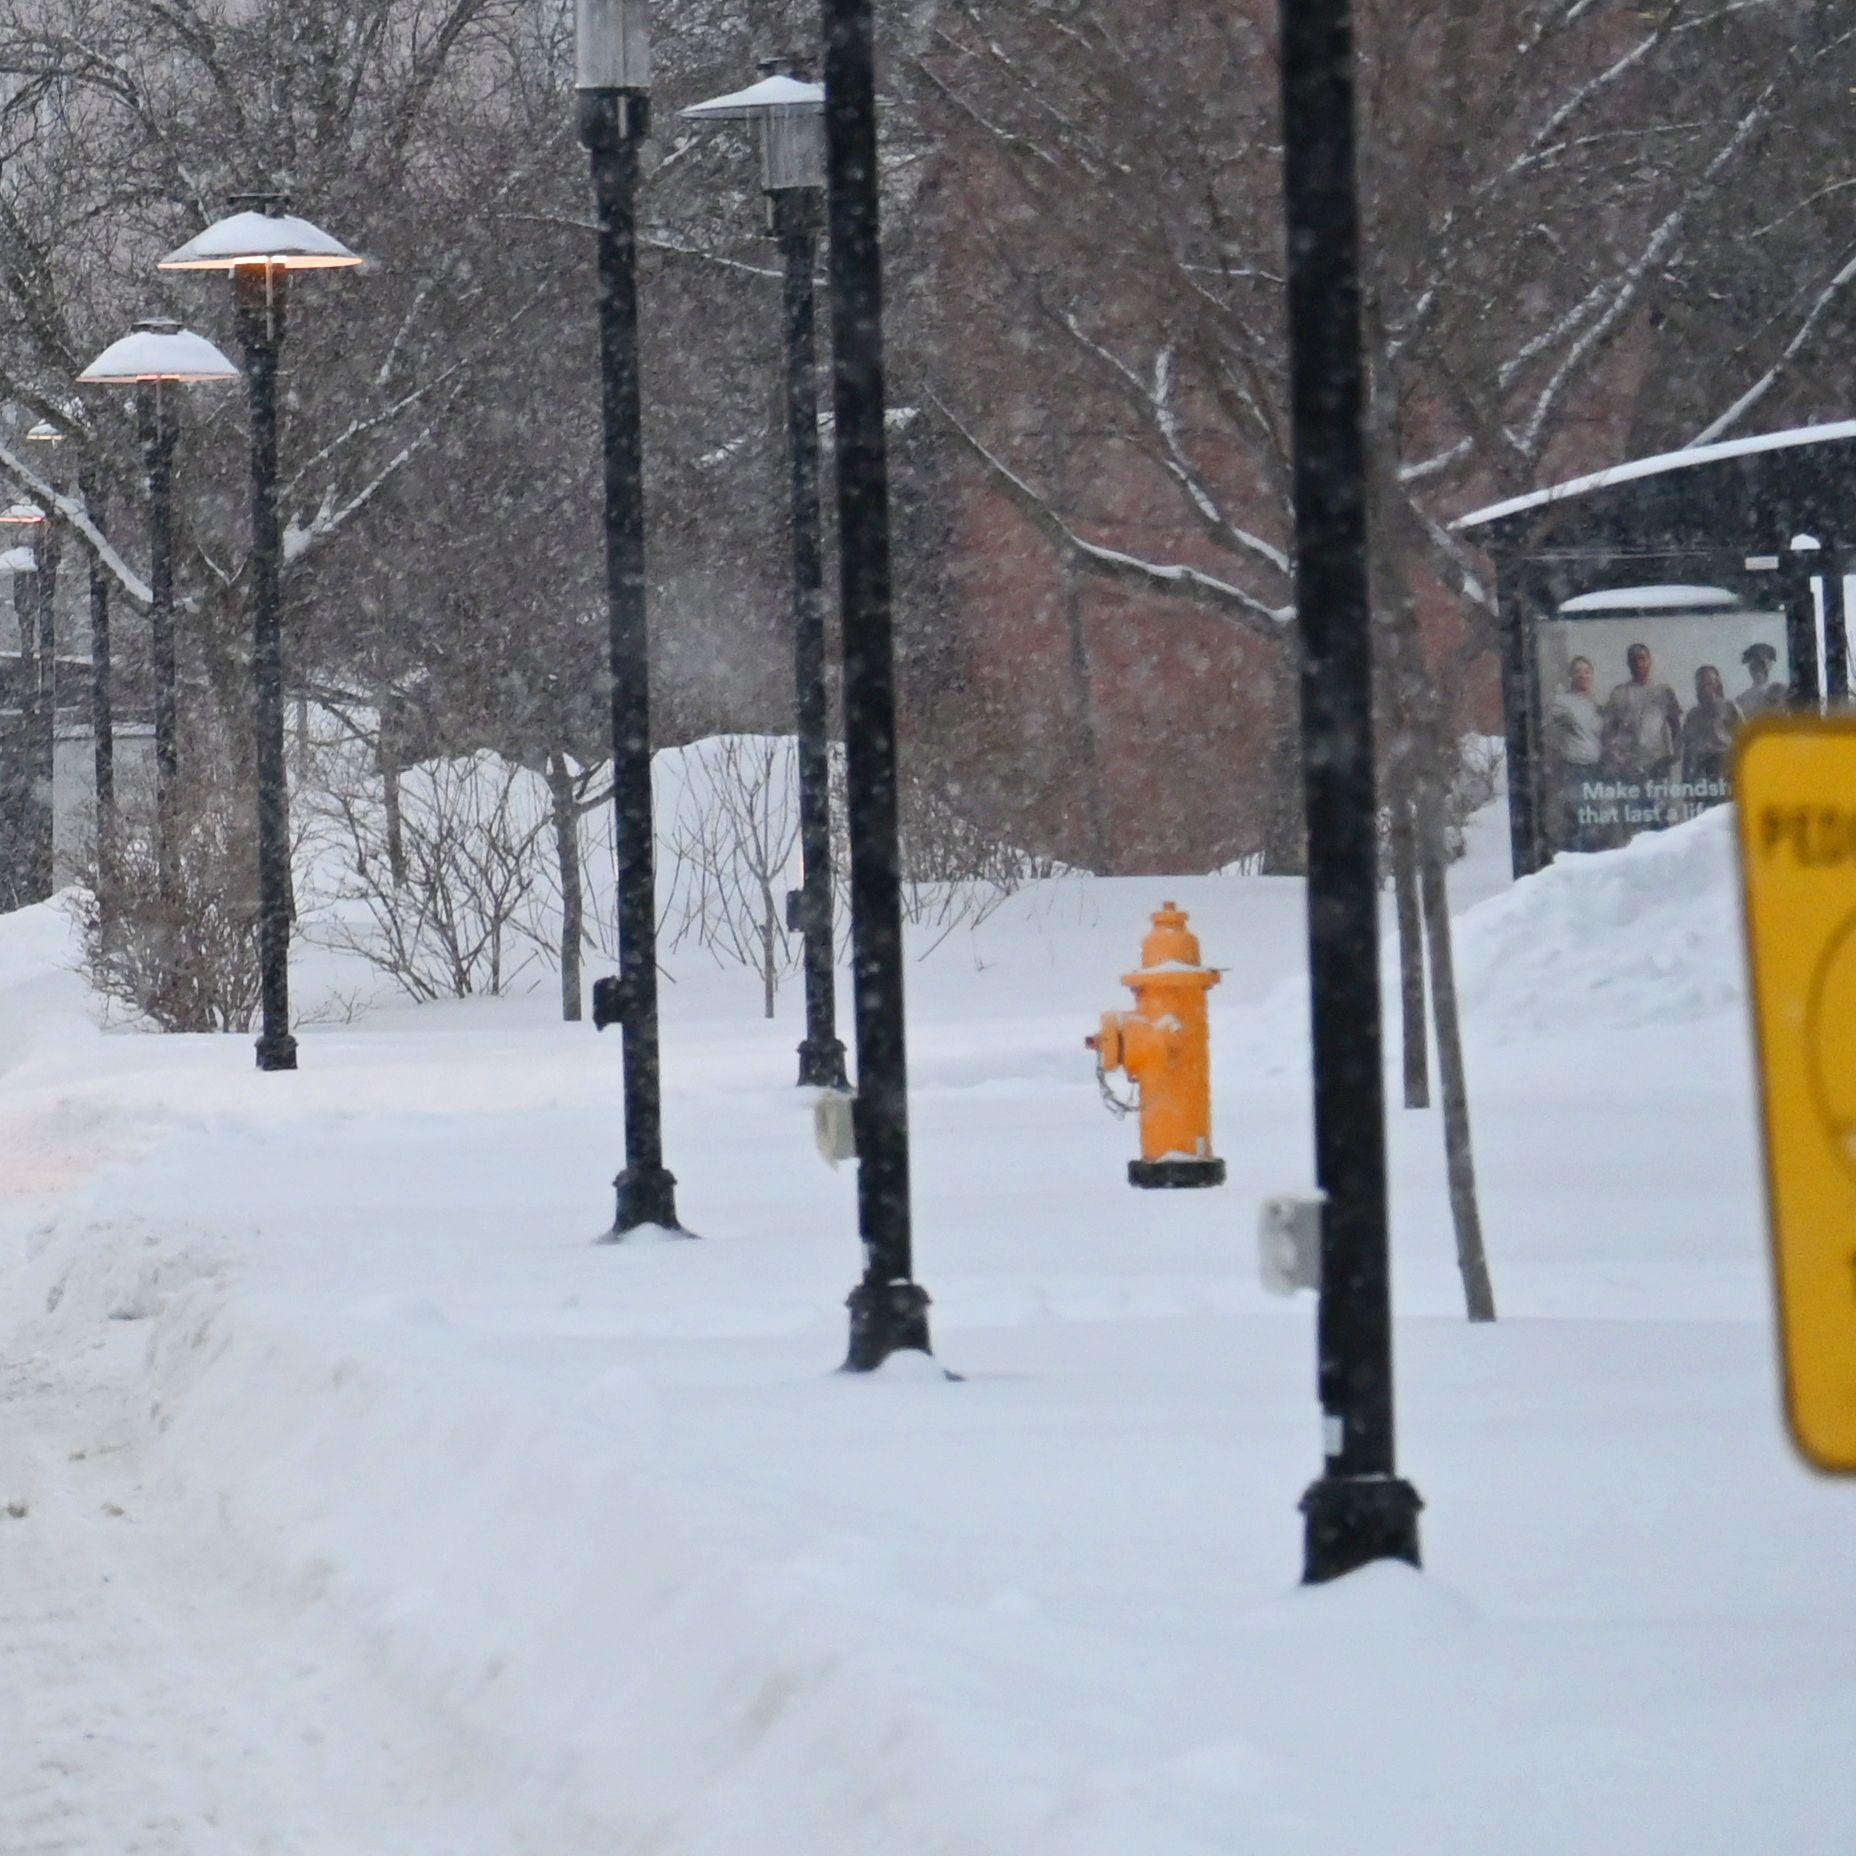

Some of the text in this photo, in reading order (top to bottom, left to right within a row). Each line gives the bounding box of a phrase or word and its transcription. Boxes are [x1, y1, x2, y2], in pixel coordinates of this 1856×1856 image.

[1582, 780, 1641, 801] Make
[1577, 804, 1620, 825] that
[1624, 803, 1662, 824] last
[1665, 806, 1680, 824] a
